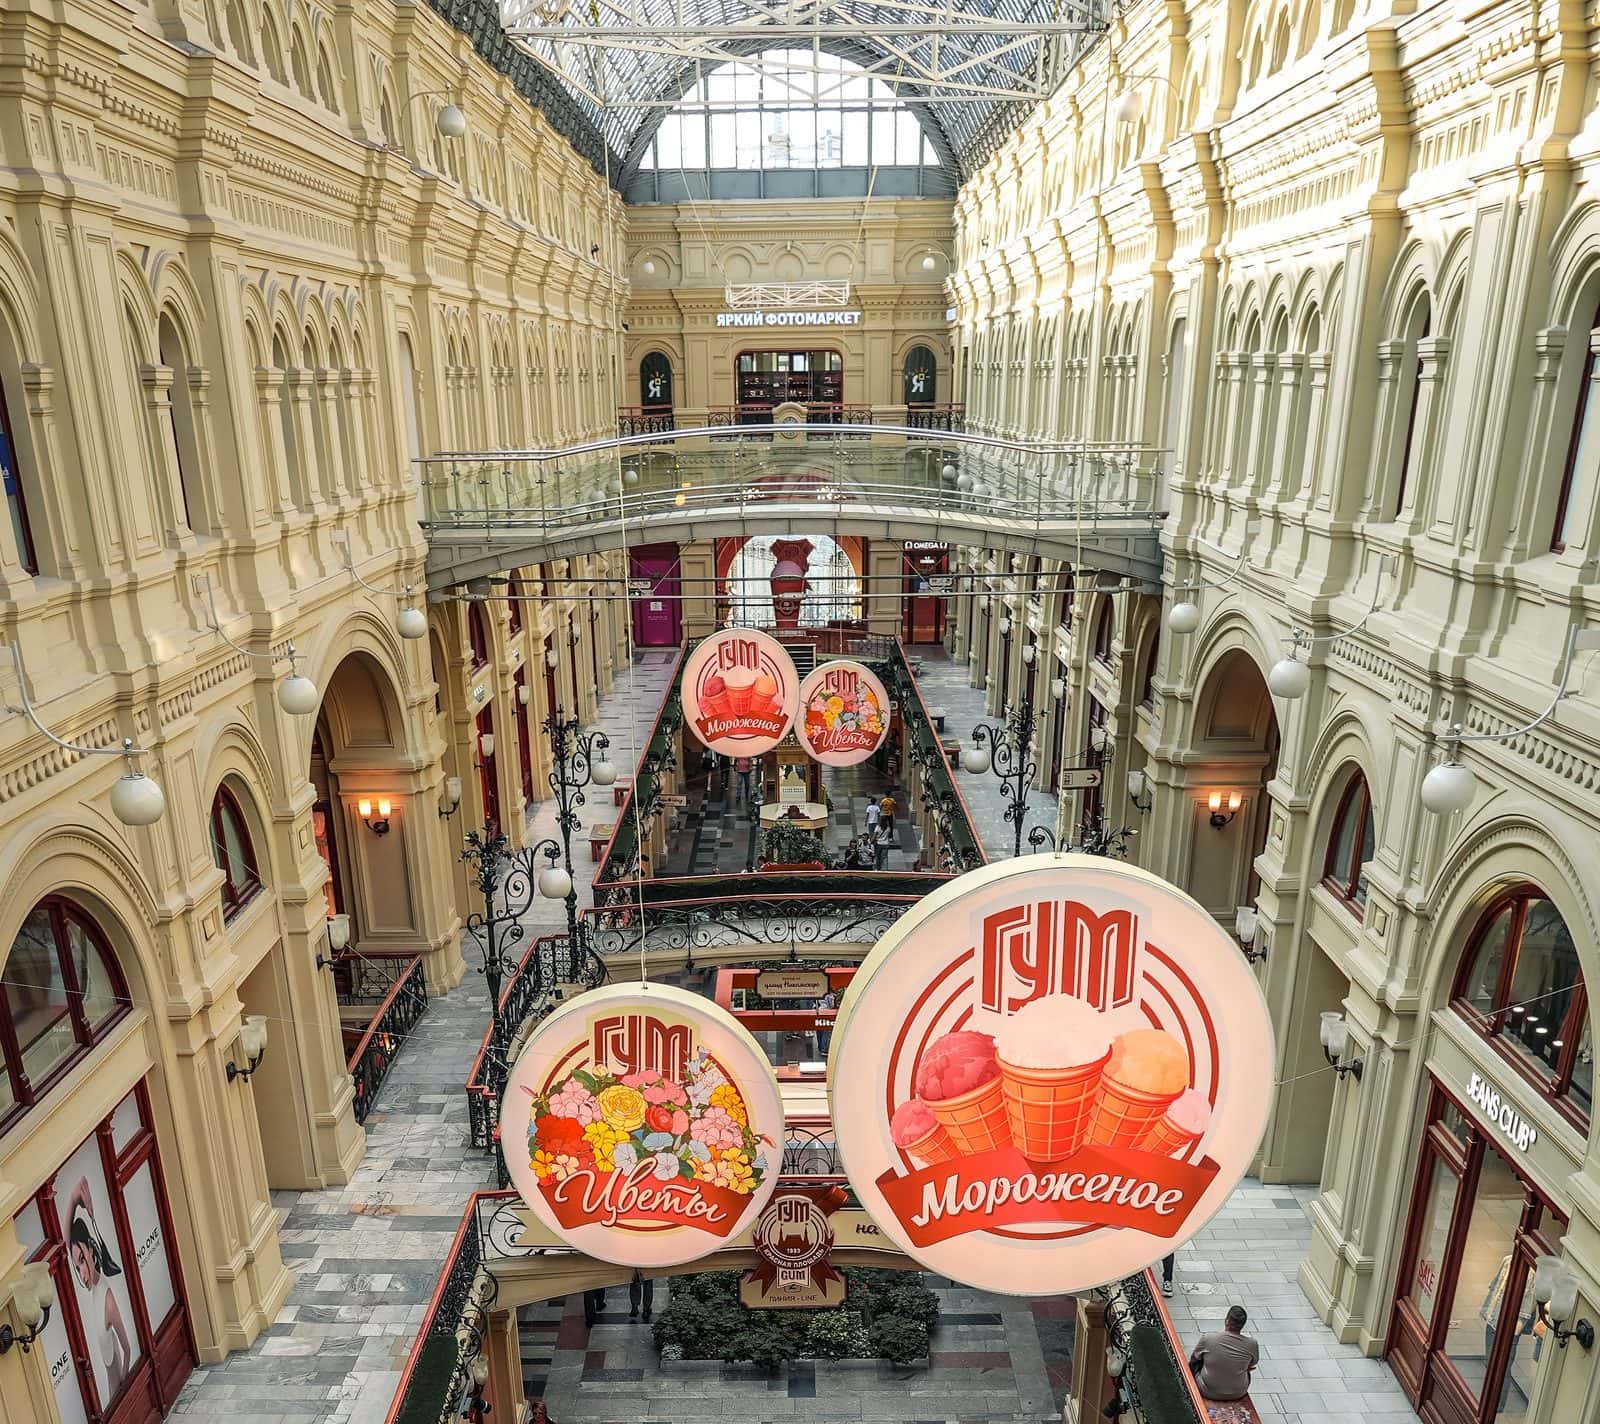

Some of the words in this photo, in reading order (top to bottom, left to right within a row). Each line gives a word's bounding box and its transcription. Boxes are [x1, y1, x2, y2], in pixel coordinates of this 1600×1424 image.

[716, 311, 763, 327] ЯРКИЙ
[765, 311, 861, 326] ФОТОМАРКЕТ
[913, 541, 939, 549] OMEGA
[718, 639, 760, 671] ГУМ
[825, 669, 859, 694] ГУМ
[705, 717, 781, 736] Мороженое
[813, 722, 873, 752] Цветы
[981, 900, 1139, 1016] ГУМ
[594, 1015, 692, 1085] ГУМ
[1466, 1072, 1501, 1121] JEANS
[554, 1156, 727, 1226] Цветы
[911, 1169, 1184, 1227] Мороженое
[777, 1200, 810, 1223] ГУМ
[146, 1227, 159, 1244] ONE
[764, 1248, 792, 1268] КРАСНАЯ
[793, 1248, 825, 1268] ПЛОЩАДЬ
[781, 1270, 806, 1280] GUM
[51, 1351, 69, 1377] ONE
